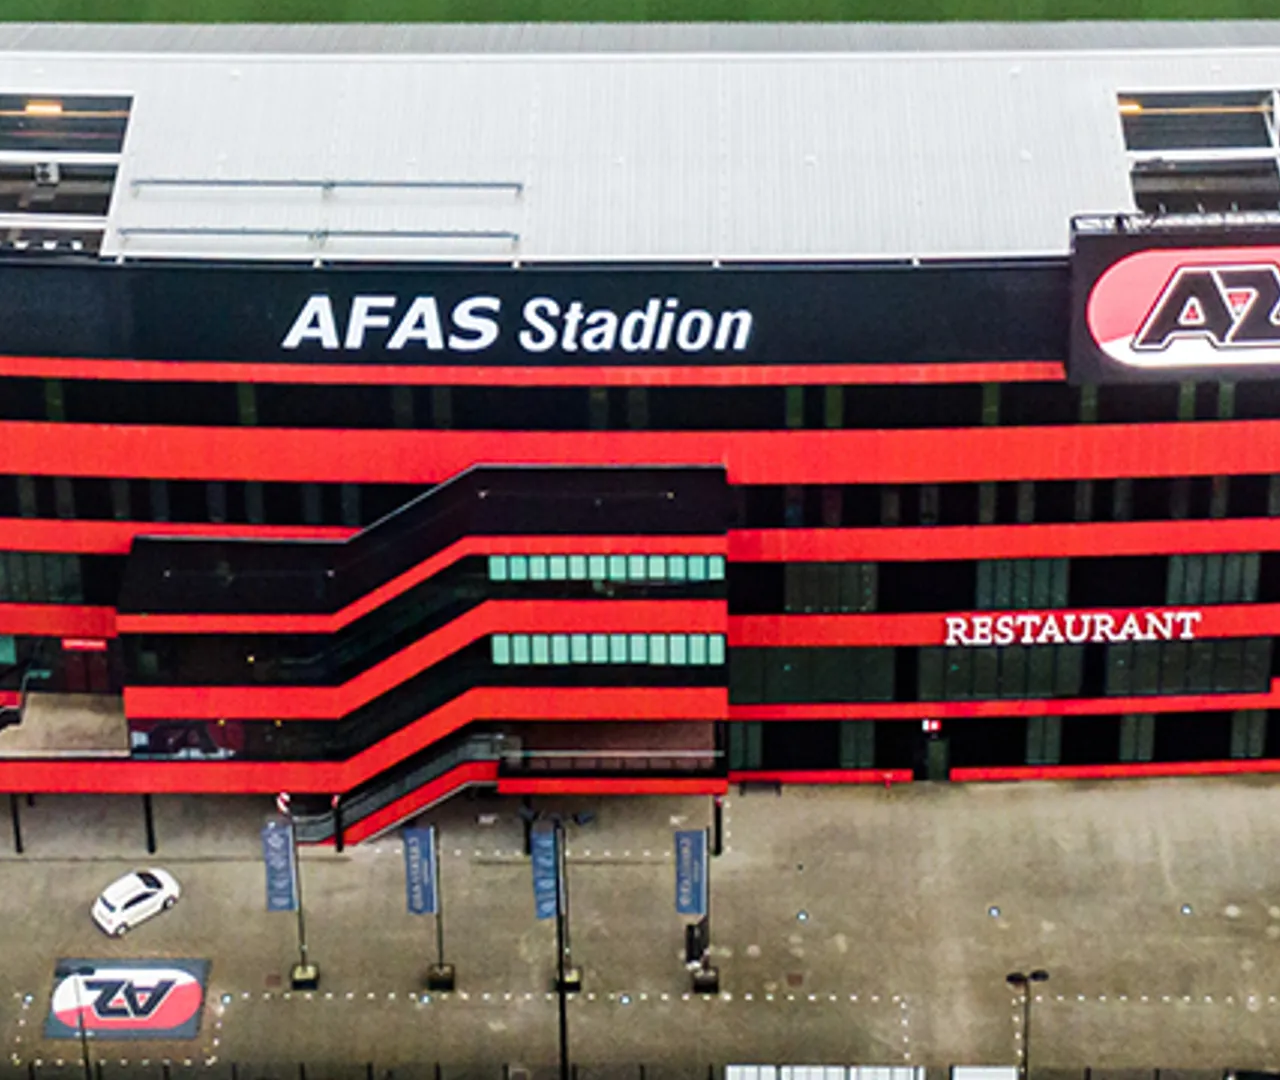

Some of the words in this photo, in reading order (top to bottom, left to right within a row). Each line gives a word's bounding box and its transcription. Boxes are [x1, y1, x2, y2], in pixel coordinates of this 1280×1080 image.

[283, 295, 501, 351] AFAS
[519, 297, 753, 352] Stadion
[945, 612, 1202, 645] RESTAURANT
[83, 979, 177, 1020] AZ
